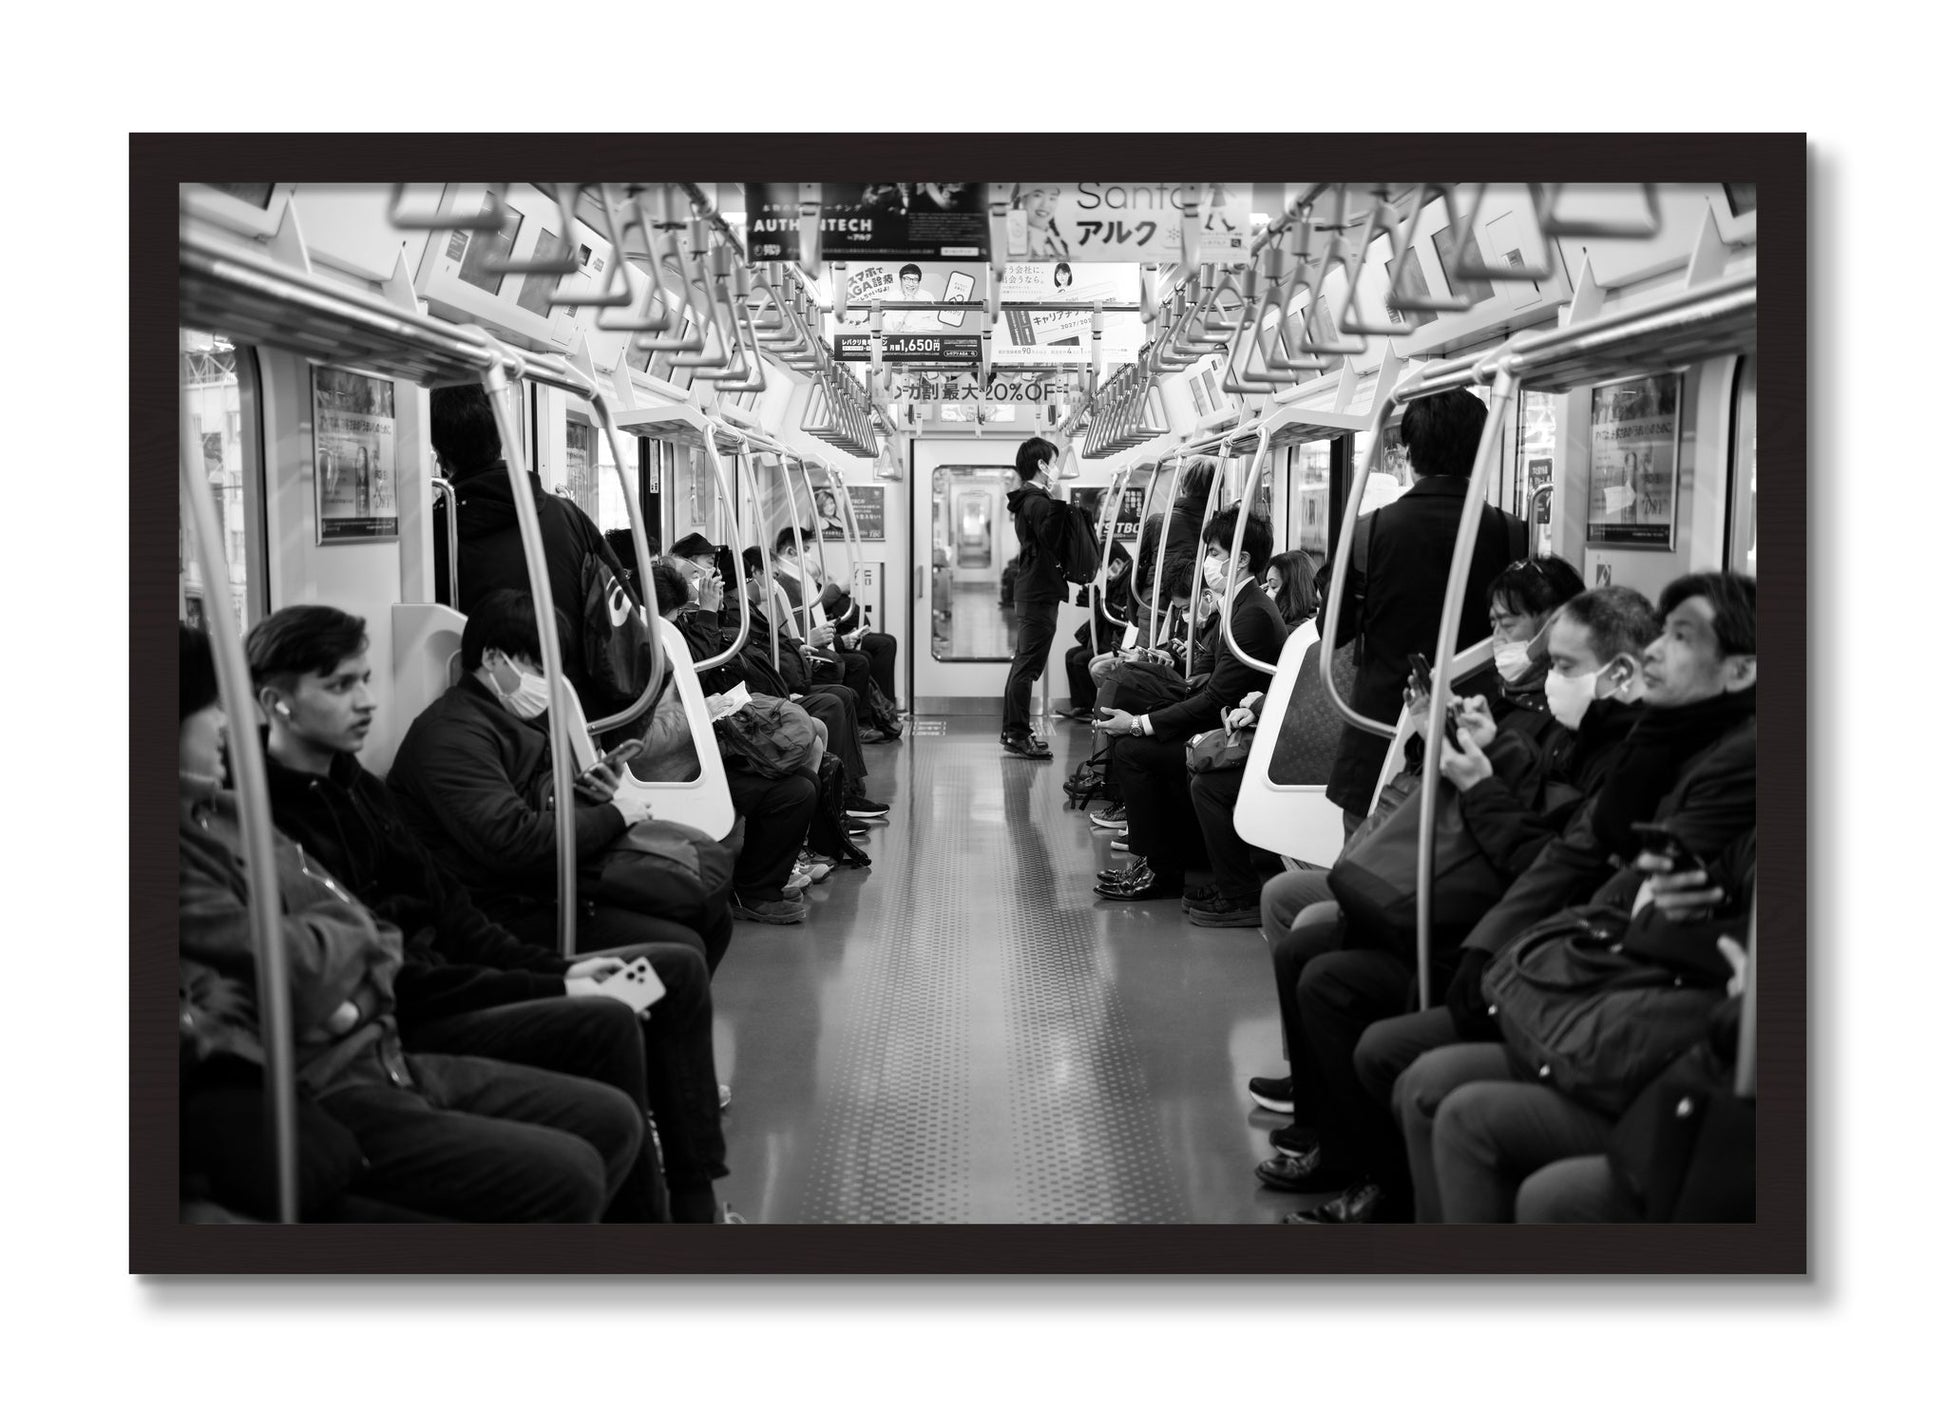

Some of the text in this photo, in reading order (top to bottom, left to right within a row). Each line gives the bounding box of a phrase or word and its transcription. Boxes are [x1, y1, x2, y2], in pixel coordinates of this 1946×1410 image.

[1077, 221, 1157, 247] アルク
[848, 267, 883, 288] スマホで
[1004, 265, 1044, 274] う会社に、
